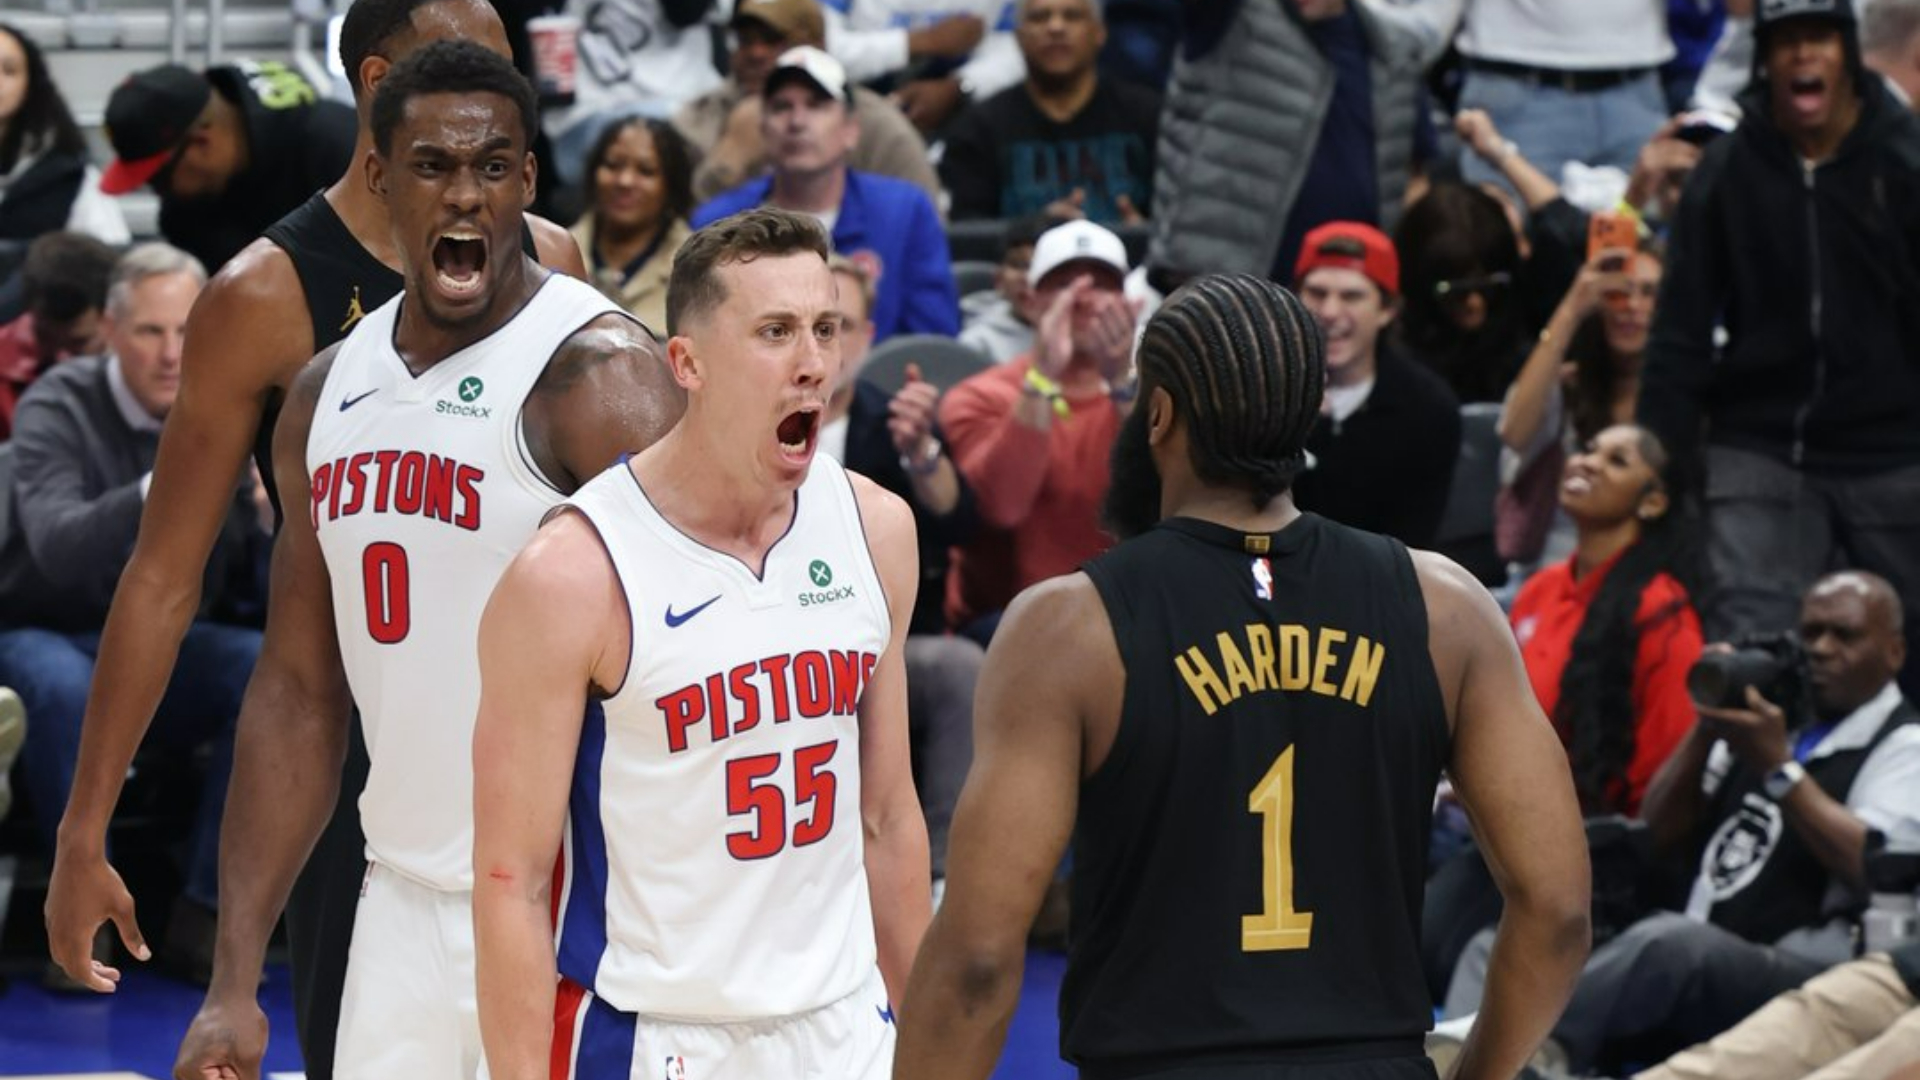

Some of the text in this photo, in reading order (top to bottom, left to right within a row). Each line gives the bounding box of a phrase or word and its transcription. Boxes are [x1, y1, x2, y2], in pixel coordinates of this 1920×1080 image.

[435, 400, 491, 418] StockX
[311, 450, 485, 532] PISTONS
[362, 541, 411, 645] 0
[798, 584, 855, 607] StockX
[1174, 623, 1386, 716] HARDEN
[725, 739, 839, 861] 55
[1241, 743, 1314, 952] 1
